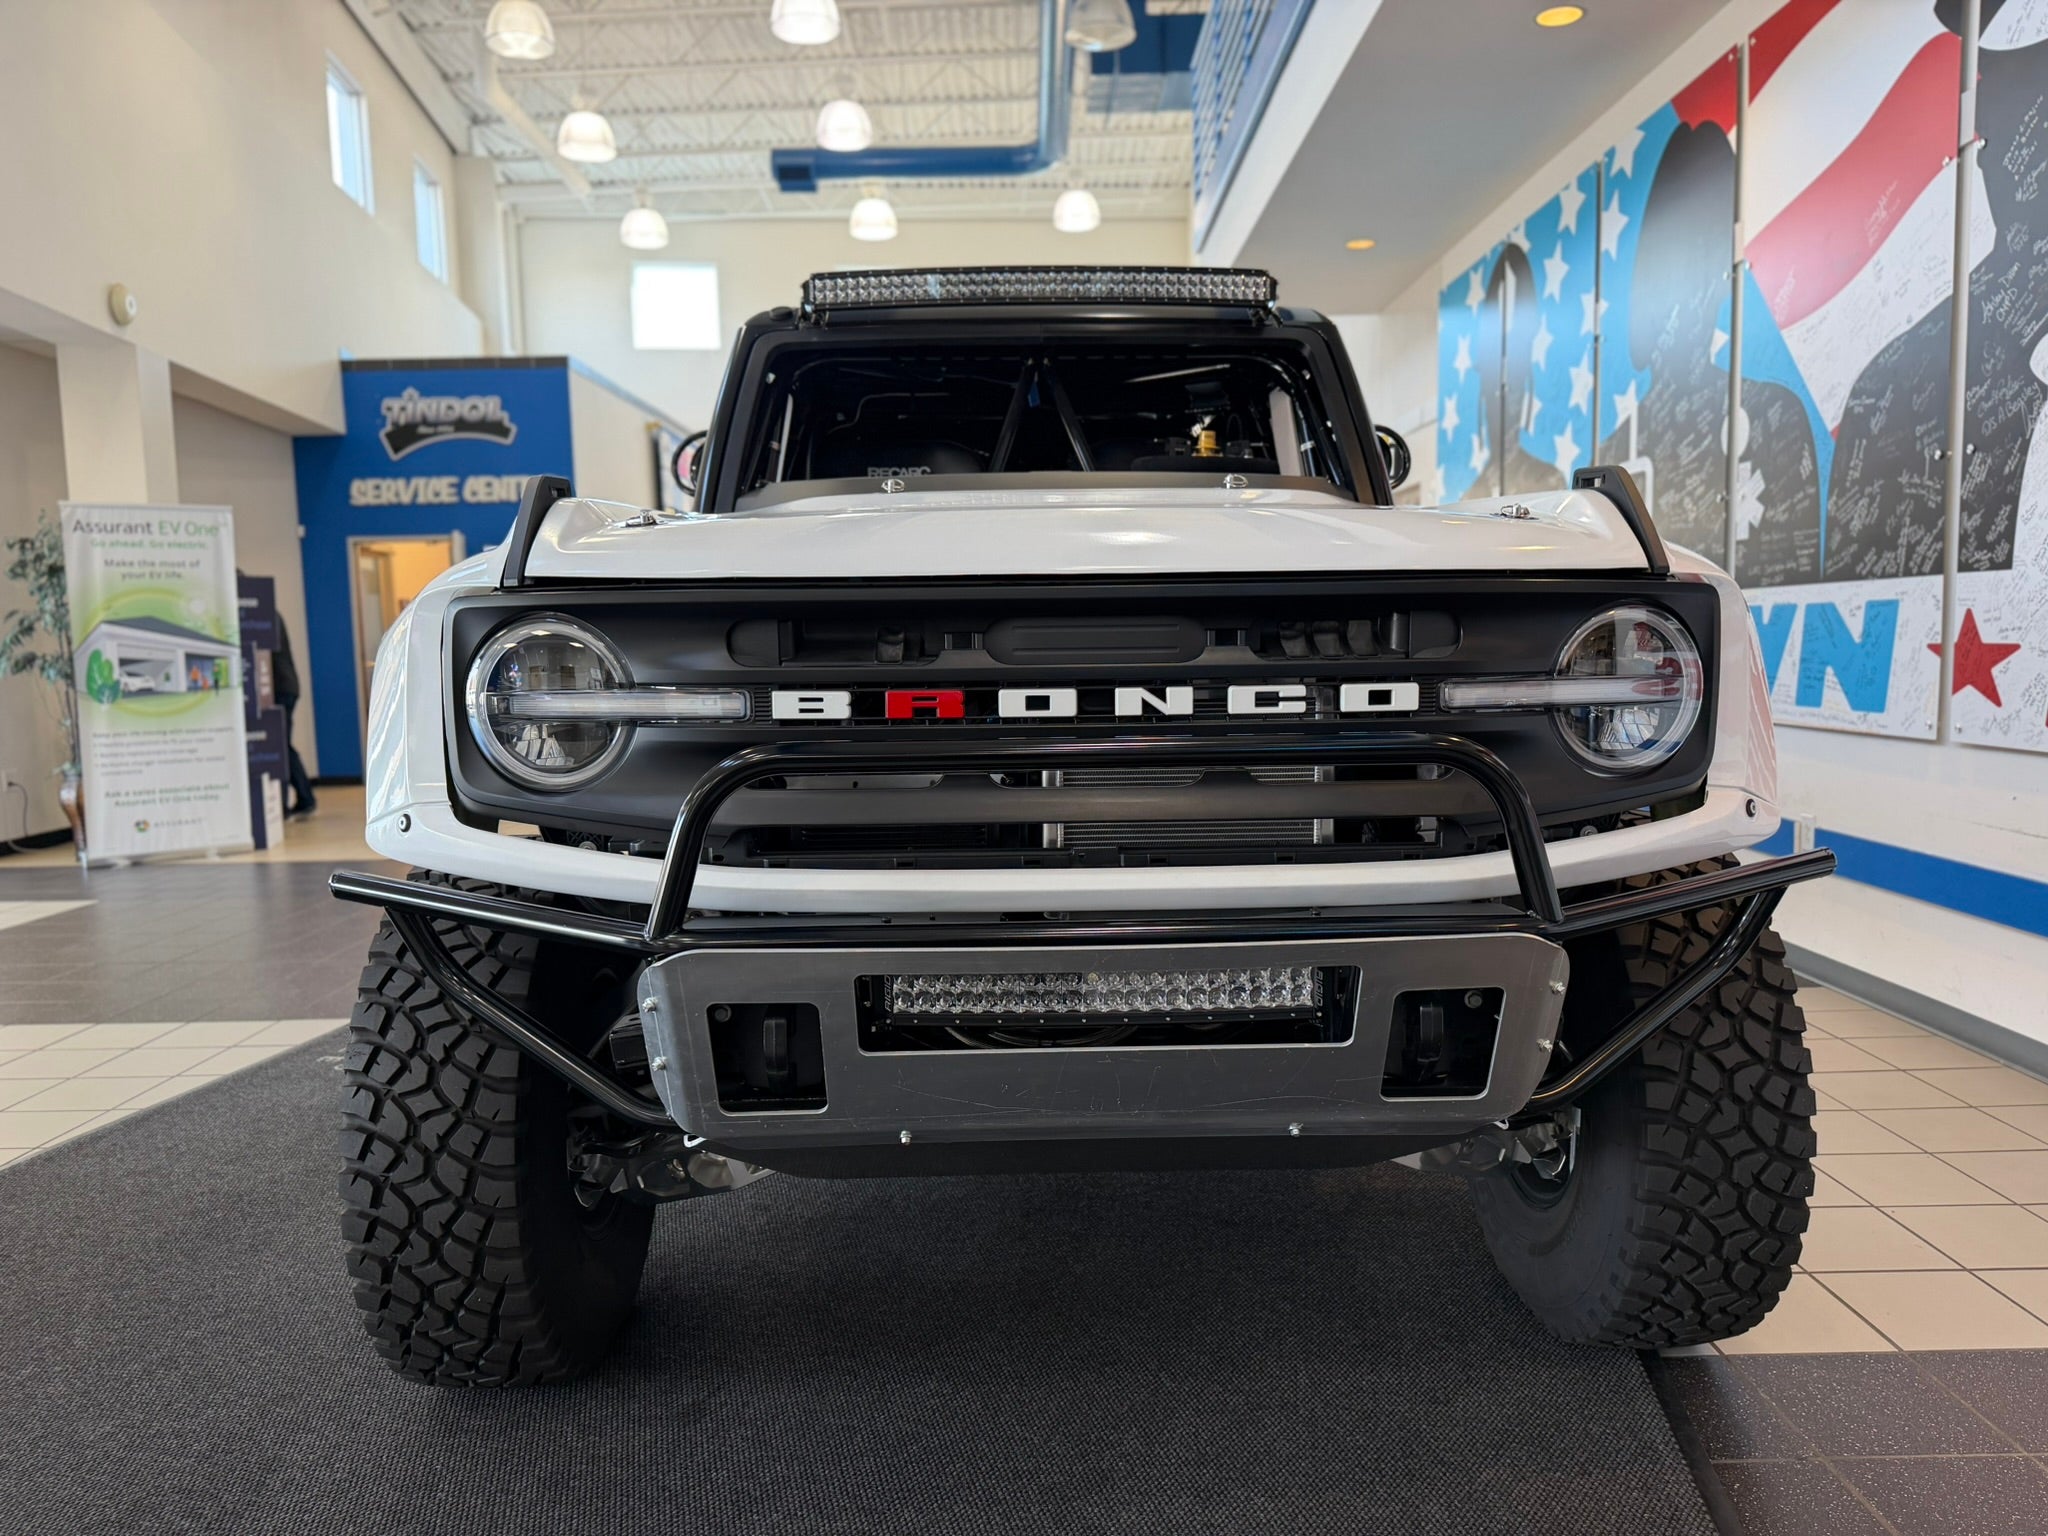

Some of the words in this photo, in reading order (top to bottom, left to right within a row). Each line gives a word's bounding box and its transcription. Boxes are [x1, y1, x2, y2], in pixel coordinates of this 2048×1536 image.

[350, 477, 460, 506] SERVICE
[72, 519, 154, 535] Assurant
[158, 520, 181, 536] EV
[104, 559, 134, 567] Make
[137, 559, 156, 567] the
[159, 560, 186, 568] most
[189, 559, 201, 567] of
[121, 572, 146, 582] your
[149, 571, 162, 580] EV
[771, 681, 1420, 719] BRONCO
